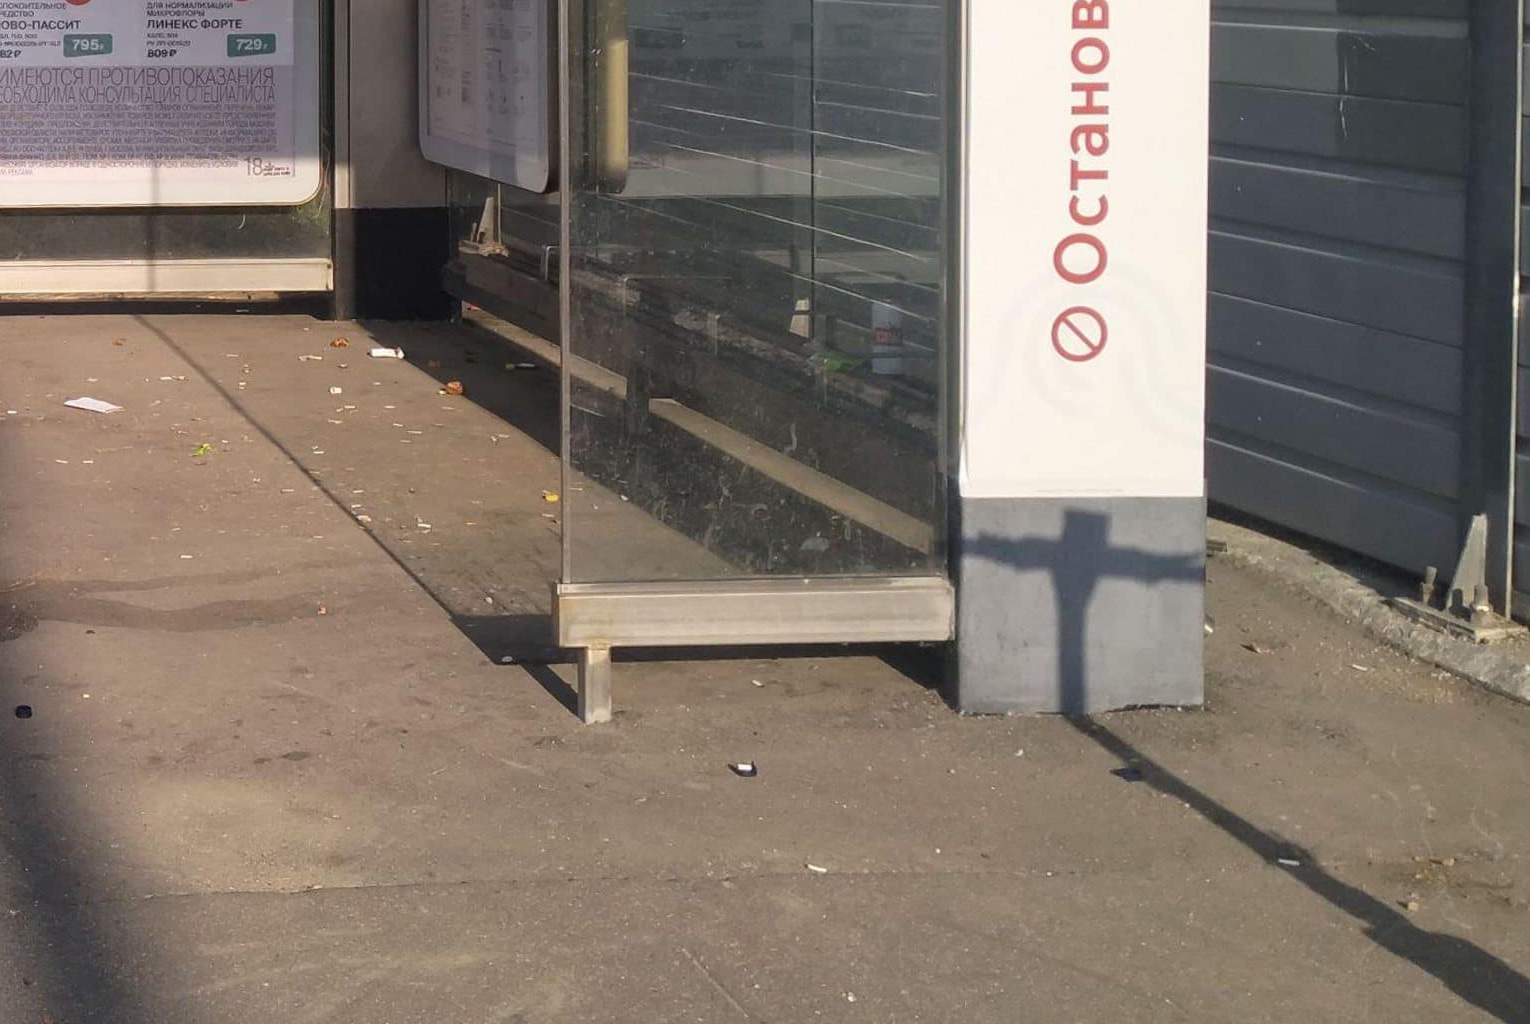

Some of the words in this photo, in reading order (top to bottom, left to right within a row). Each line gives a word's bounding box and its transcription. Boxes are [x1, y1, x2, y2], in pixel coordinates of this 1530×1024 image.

[146, 19, 198, 29] ЛИНЕКС
[200, 19, 243, 29] ФОРТЕ
[78, 85, 181, 104] КОНСУЛЬТАЦИЯ
[185, 84, 276, 103] СПЕЦИАЛИСТА
